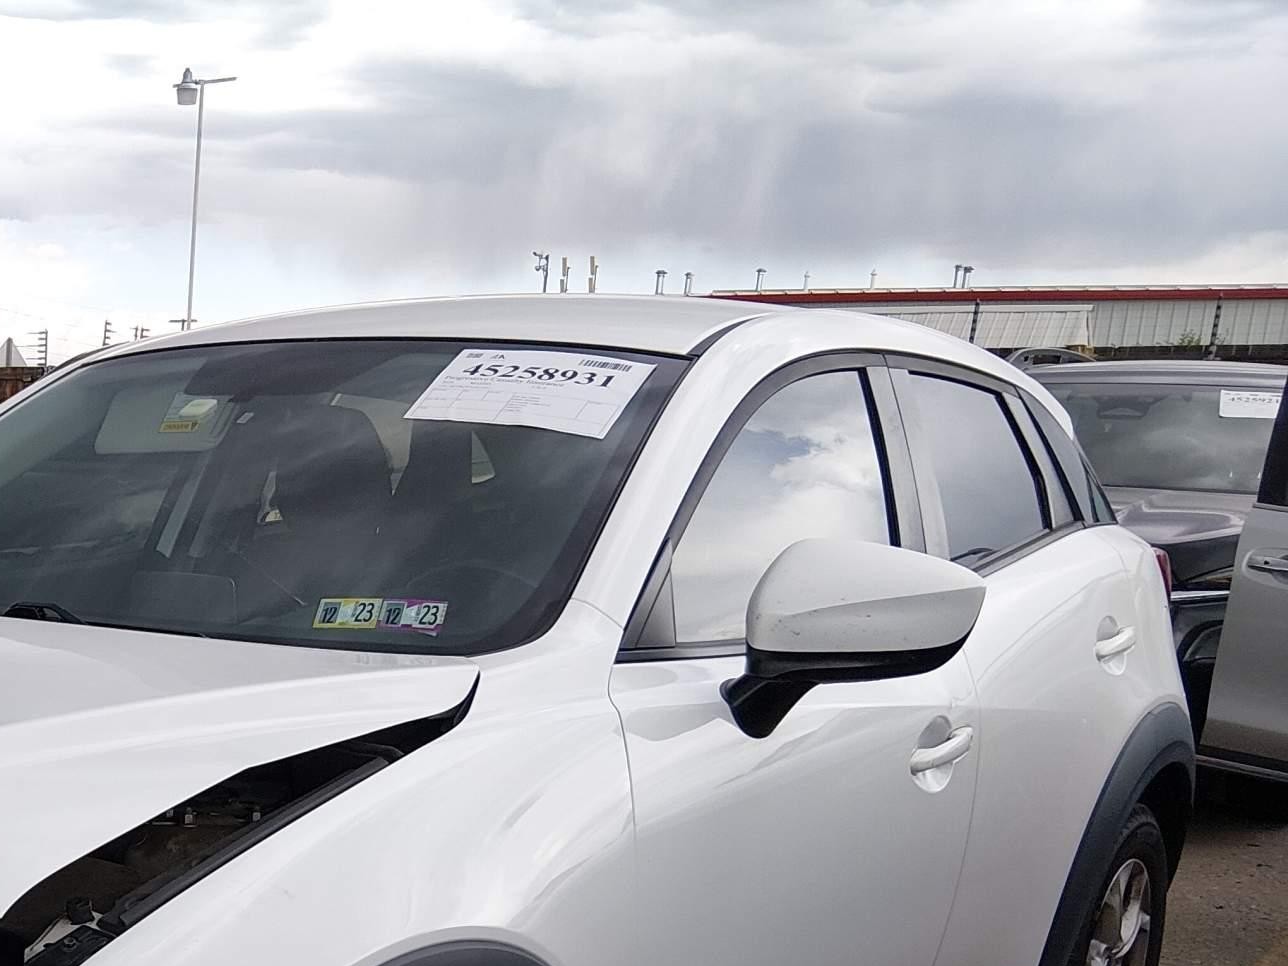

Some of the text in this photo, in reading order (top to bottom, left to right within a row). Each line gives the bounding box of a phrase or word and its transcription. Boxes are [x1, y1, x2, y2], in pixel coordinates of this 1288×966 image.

[463, 363, 615, 388] 45258931
[321, 602, 375, 623] 12 23
[385, 604, 440, 625] 12 23
